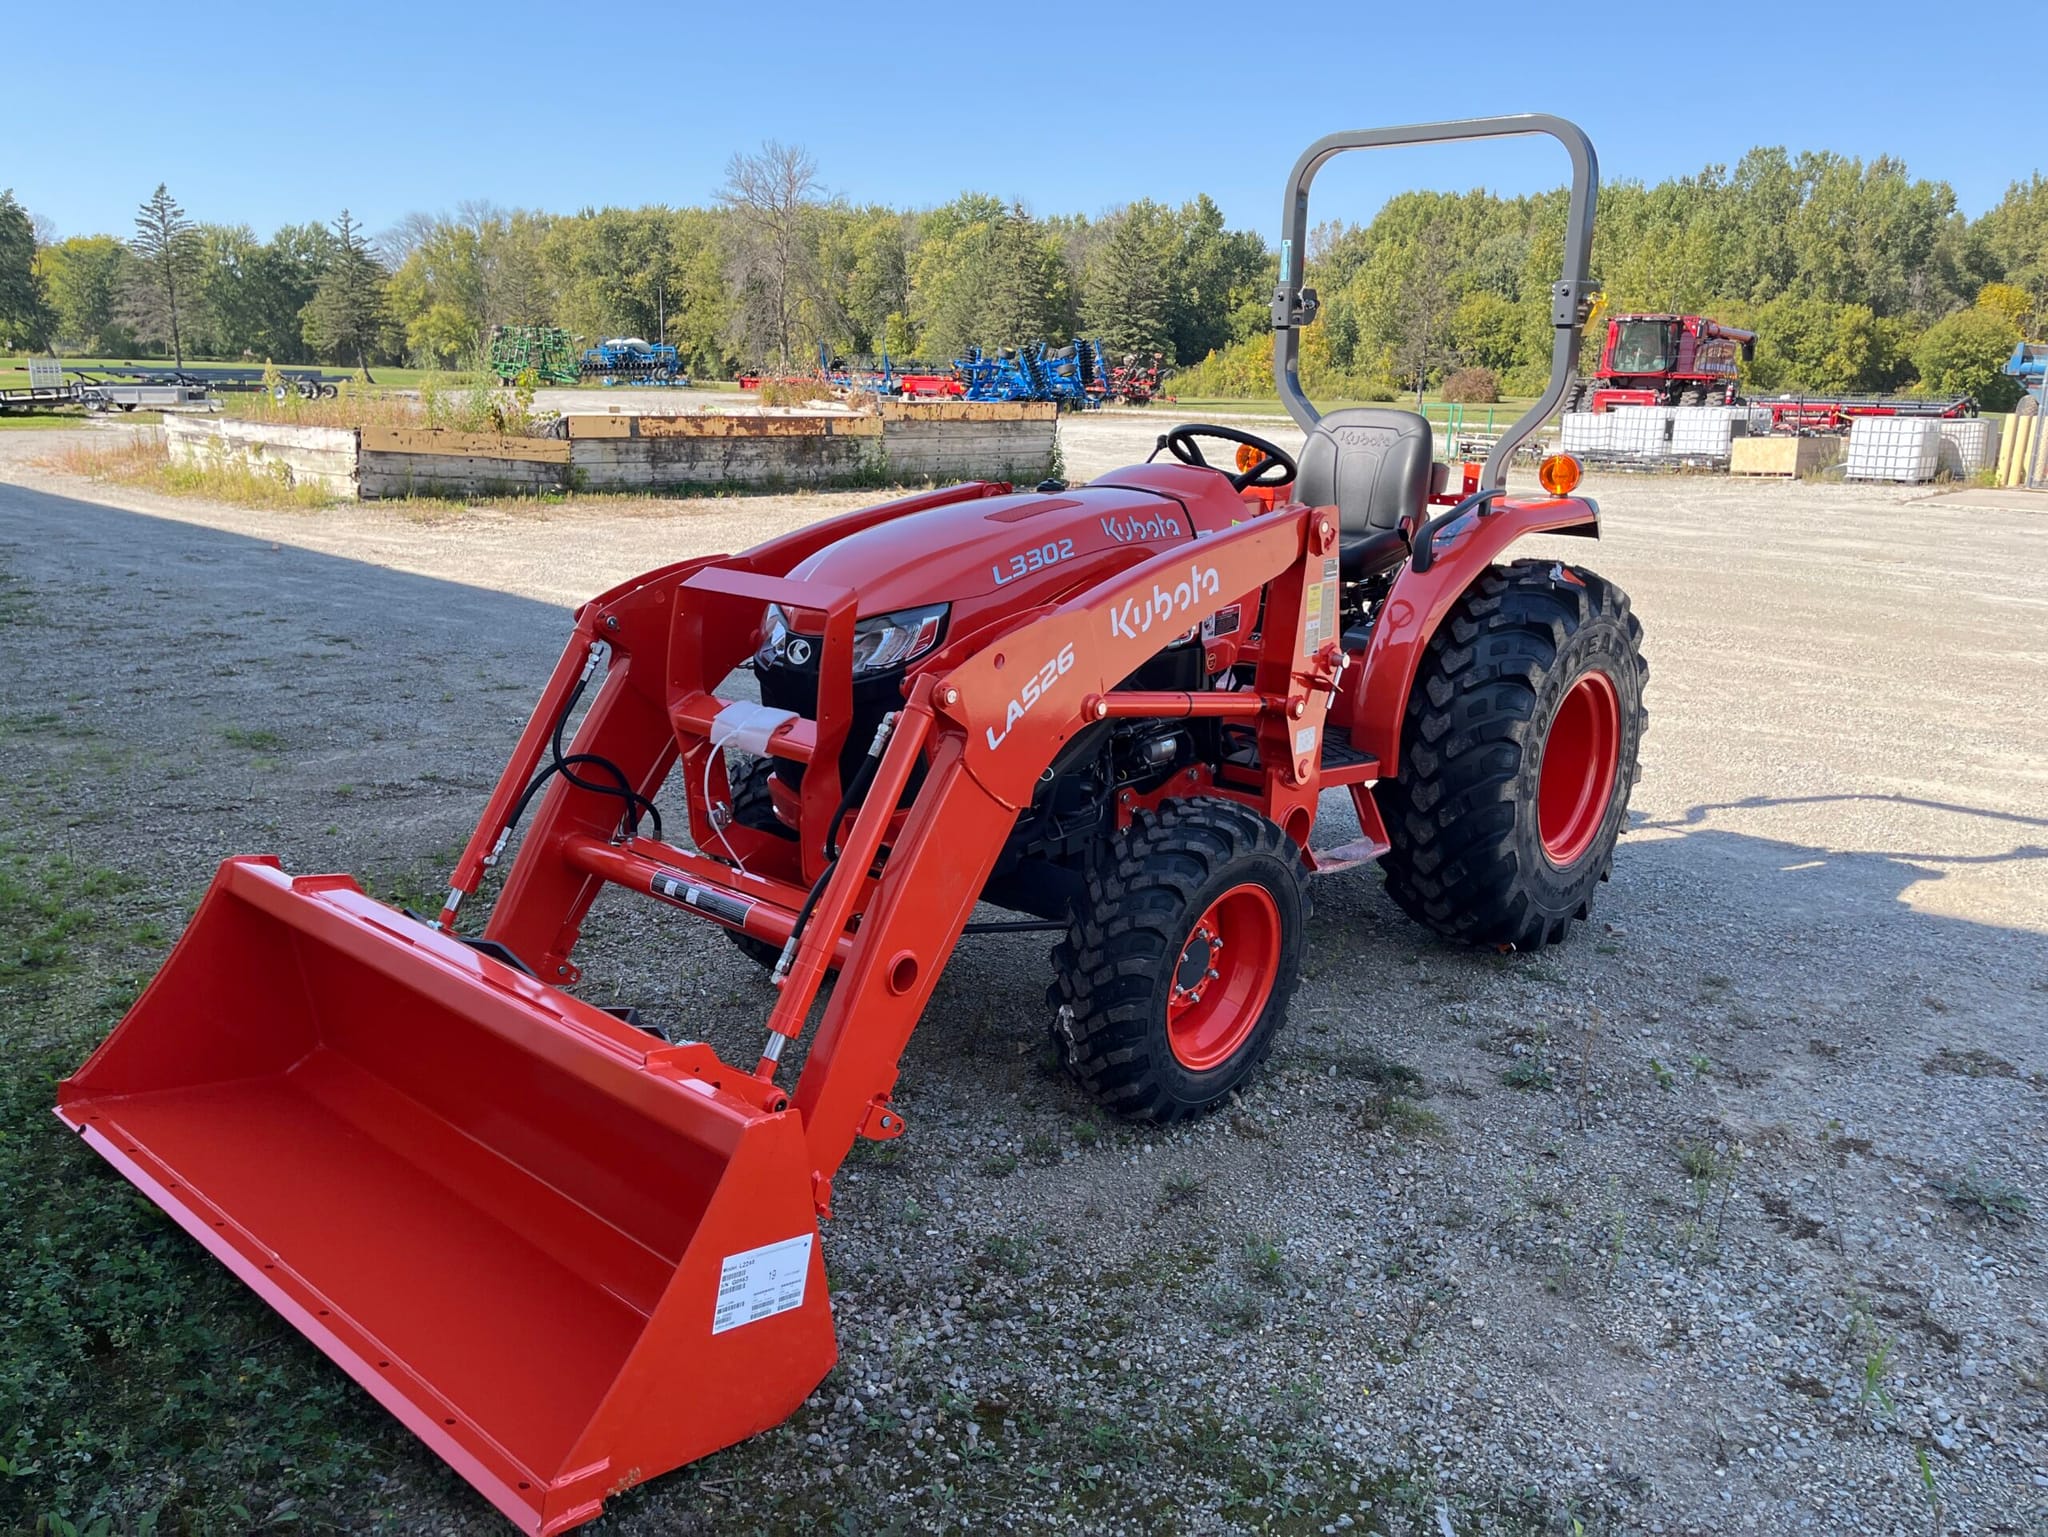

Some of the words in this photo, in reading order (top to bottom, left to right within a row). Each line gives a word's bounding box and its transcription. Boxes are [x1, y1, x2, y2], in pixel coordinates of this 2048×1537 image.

[1340, 431, 1393, 448] Kubota
[1100, 513, 1180, 543] Kubota
[992, 538, 1075, 586] L3302
[1110, 565, 1220, 640] Kubota
[985, 642, 1075, 751] LA526
